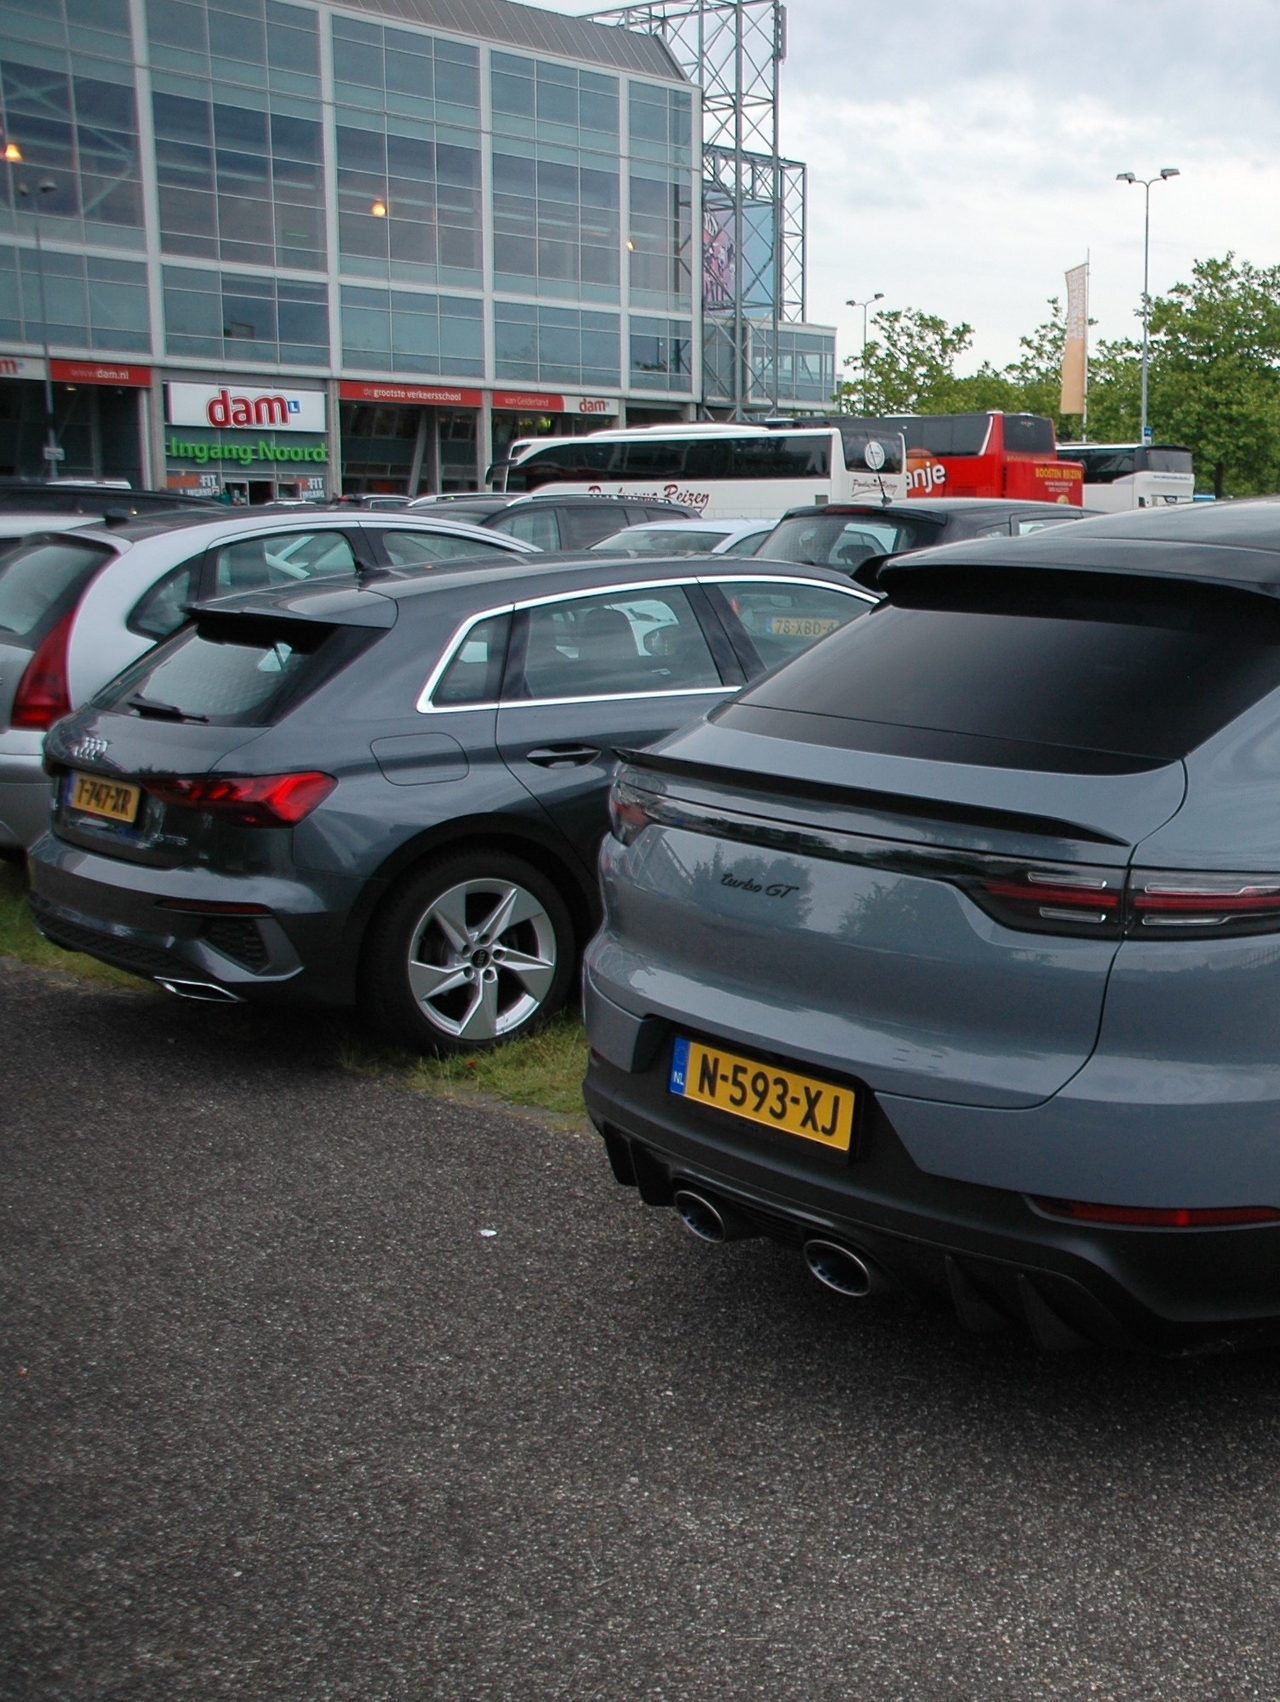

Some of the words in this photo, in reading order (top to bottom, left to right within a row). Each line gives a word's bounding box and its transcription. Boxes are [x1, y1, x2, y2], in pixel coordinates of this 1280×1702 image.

[207, 388, 291, 428] dam
[373, 388, 406, 400] grootste
[406, 390, 461, 402] verkeersschool
[578, 397, 606, 413] dam
[170, 437, 253, 465] Ingang
[257, 441, 326, 462] Noord
[906, 461, 946, 494] anje
[720, 872, 763, 893] turbo
[765, 883, 800, 898] GT
[673, 1070, 684, 1087] NL
[697, 1053, 841, 1137] N-593-XJ
